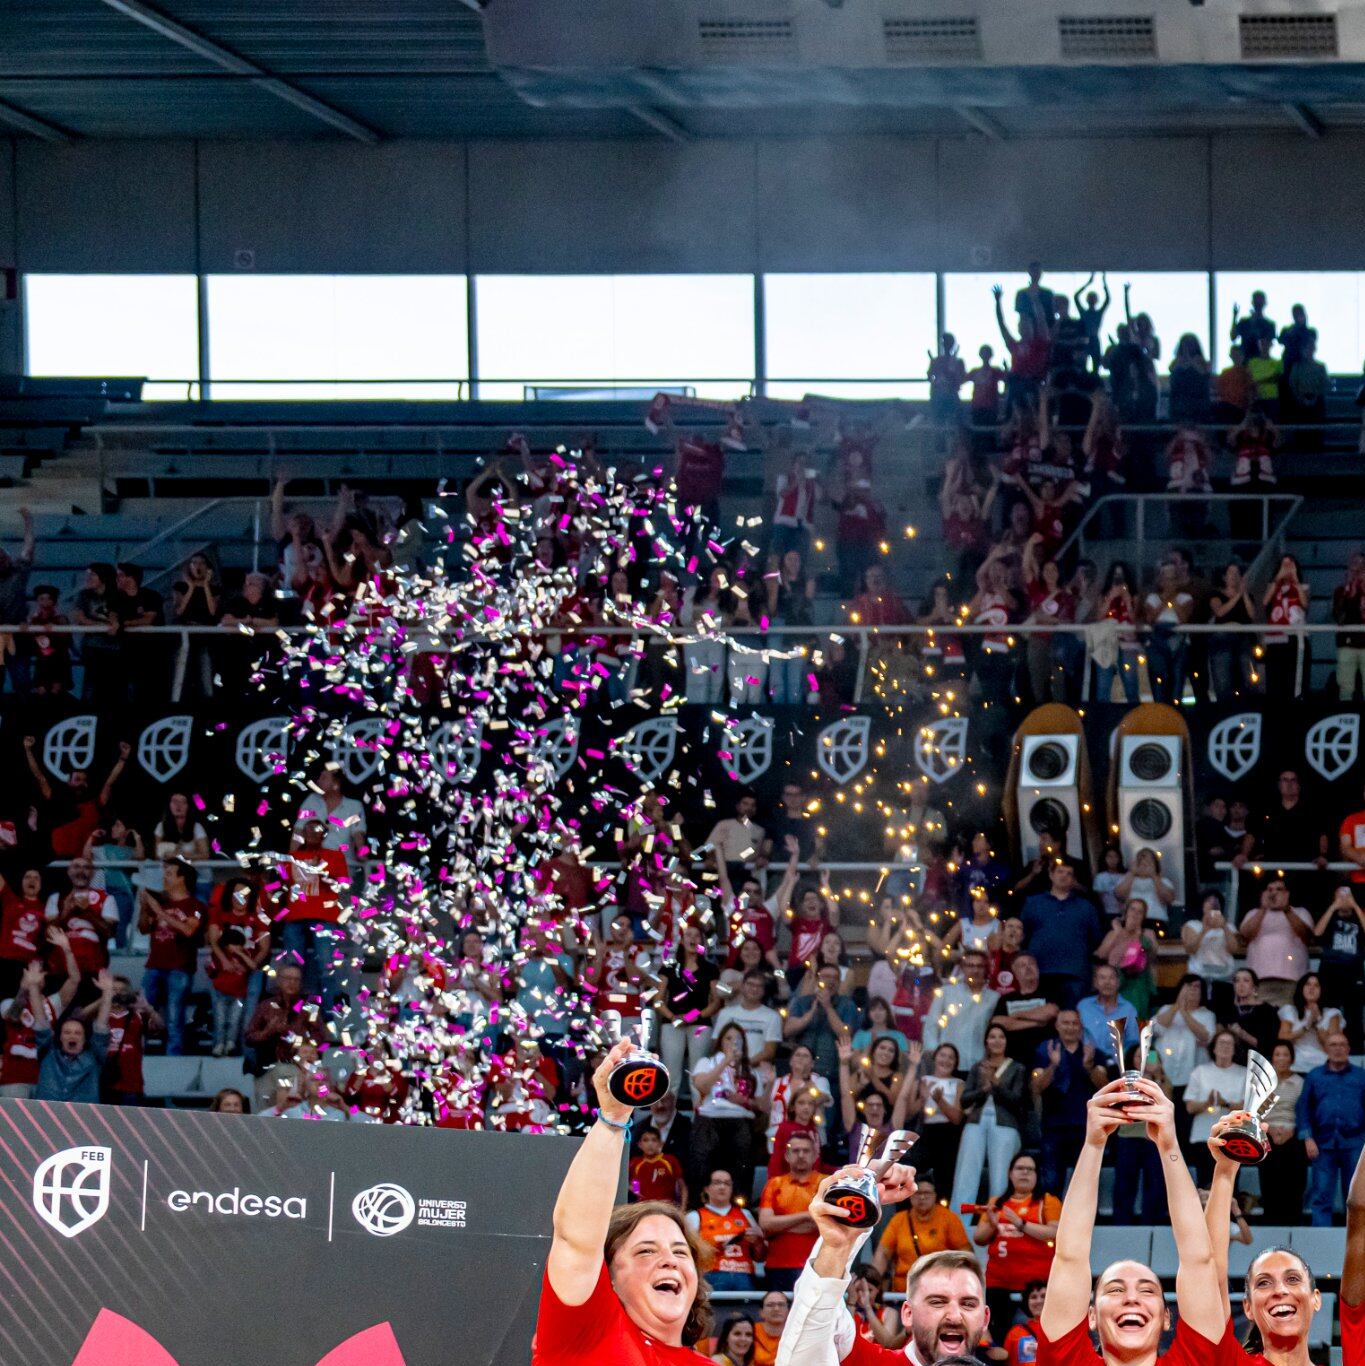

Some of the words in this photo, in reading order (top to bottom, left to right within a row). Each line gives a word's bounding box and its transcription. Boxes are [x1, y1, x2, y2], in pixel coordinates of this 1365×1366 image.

[81, 1151, 105, 1161] FEB
[167, 1187, 307, 1218] endesa
[418, 1199, 467, 1210] UNIVERSO
[418, 1207, 466, 1220] MUJER
[417, 1218, 467, 1227] BALONCESTO
